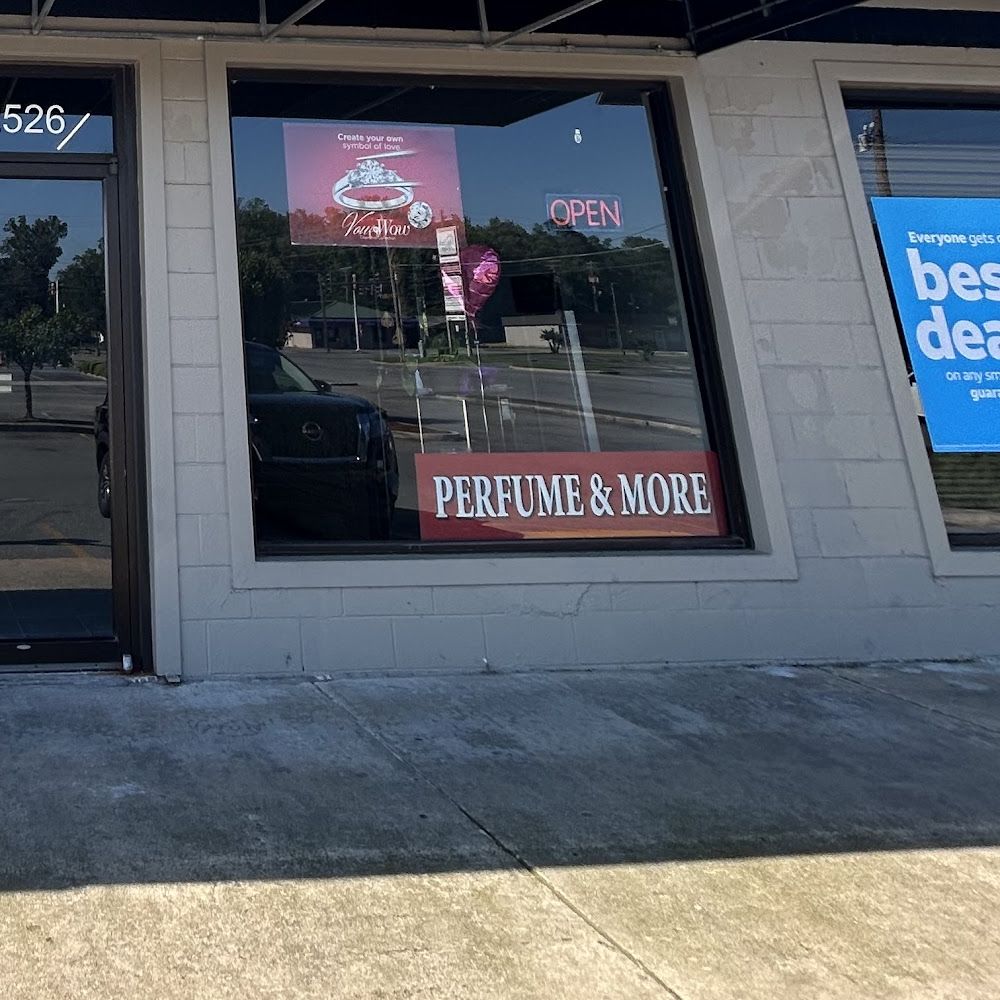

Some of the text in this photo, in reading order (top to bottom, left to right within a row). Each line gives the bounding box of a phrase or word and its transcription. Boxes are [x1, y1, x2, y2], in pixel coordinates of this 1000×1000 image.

[337, 133, 365, 141] Create
[342, 142, 401, 151] symbol of love
[550, 199, 621, 227] OPEN
[907, 231, 967, 247] Everyone
[969, 233, 995, 247] gets
[946, 371, 961, 381] on
[962, 371, 983, 384] any
[433, 472, 711, 518] PERFUME & MORE
